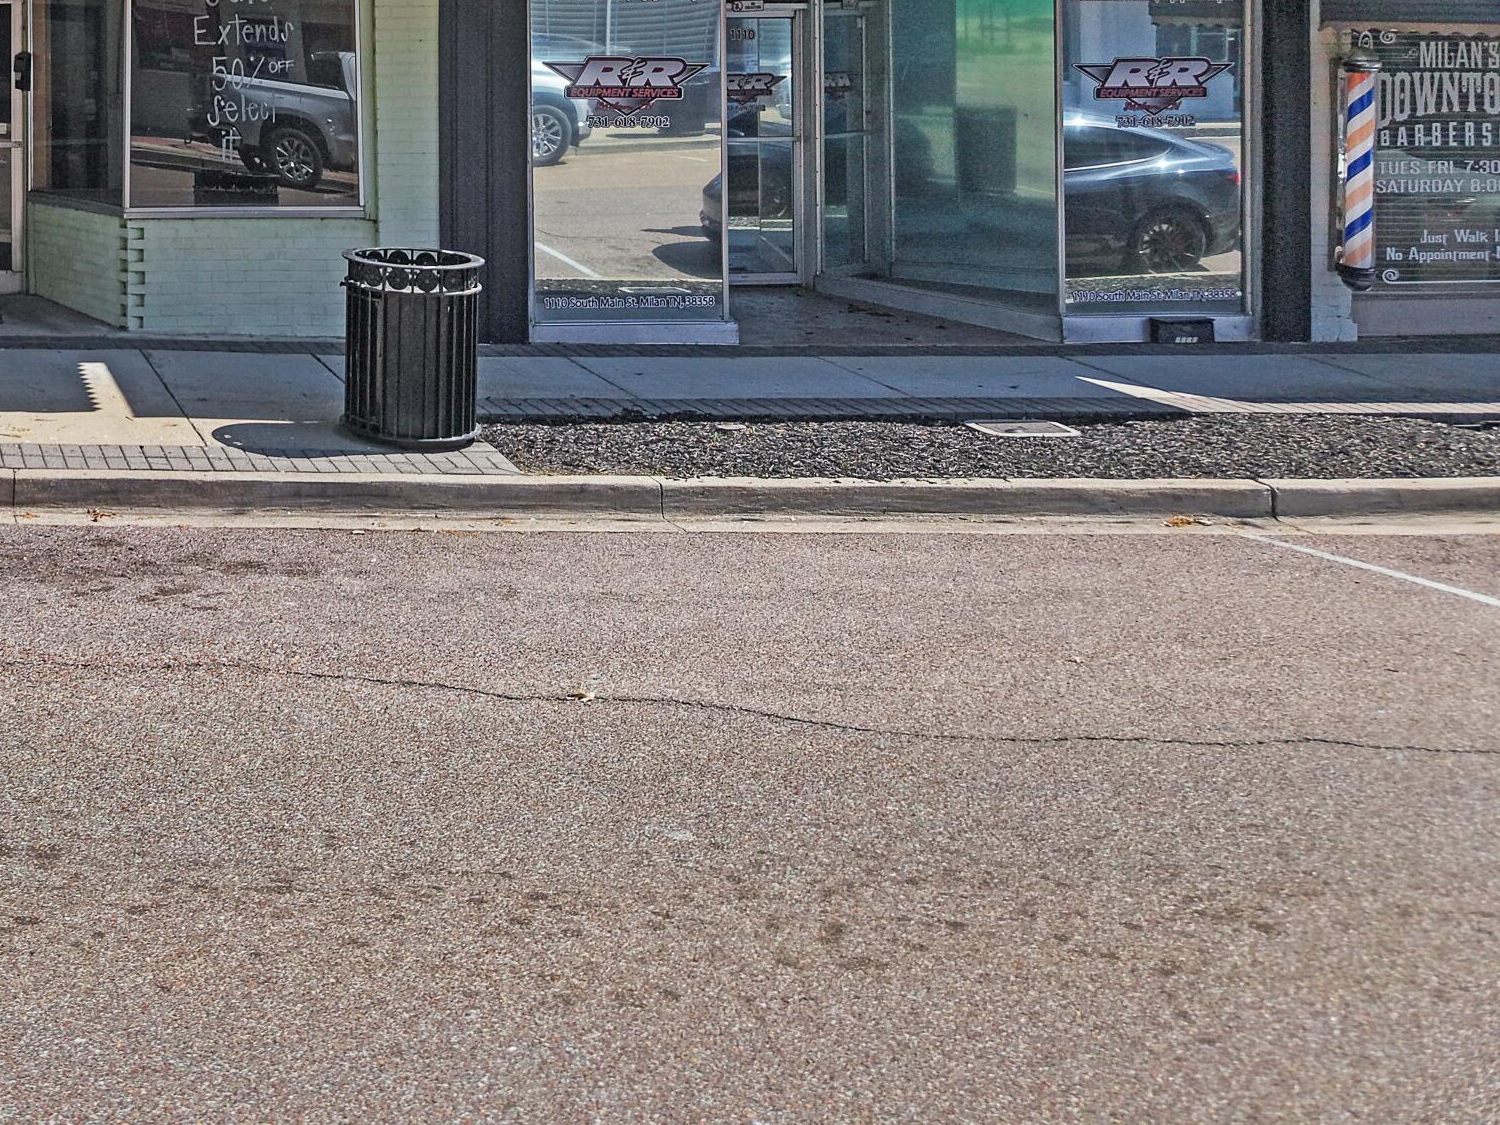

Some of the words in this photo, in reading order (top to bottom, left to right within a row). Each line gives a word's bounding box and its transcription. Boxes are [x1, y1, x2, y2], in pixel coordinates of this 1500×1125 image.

[193, 14, 294, 46] Extends
[730, 28, 755, 41] 1110
[1420, 41, 1500, 68] MILAN'S
[212, 56, 266, 91] 50%
[269, 60, 295, 74] OFF
[576, 57, 685, 88] R&R
[1104, 57, 1210, 88] R&R
[570, 87, 630, 98] EQUIPMENT
[631, 88, 679, 98] SERVICES
[1100, 87, 1159, 98] EQUIPMENT
[1159, 87, 1205, 97] SERVICES
[587, 115, 670, 129] 731-618-7902
[1115, 114, 1197, 128] 731-618-7902
[1380, 122, 1500, 147] BARBERS
[1378, 161, 1420, 175] TUES
[1427, 160, 1454, 174] FRI
[1376, 179, 1463, 193] SATURDAY
[1420, 229, 1448, 245] Just
[1454, 229, 1489, 243] Walk
[1386, 247, 1403, 261] No
[1408, 247, 1491, 263] Appointment
[544, 297, 569, 308] 1110
[569, 296, 599, 308] South
[600, 296, 624, 308] Main
[639, 296, 666, 307] Milan
[685, 295, 716, 308] 38358
[1097, 290, 1125, 302] South
[1126, 290, 1150, 301] Main
[1164, 290, 1191, 301] Milan
[1207, 288, 1236, 300] 38358
